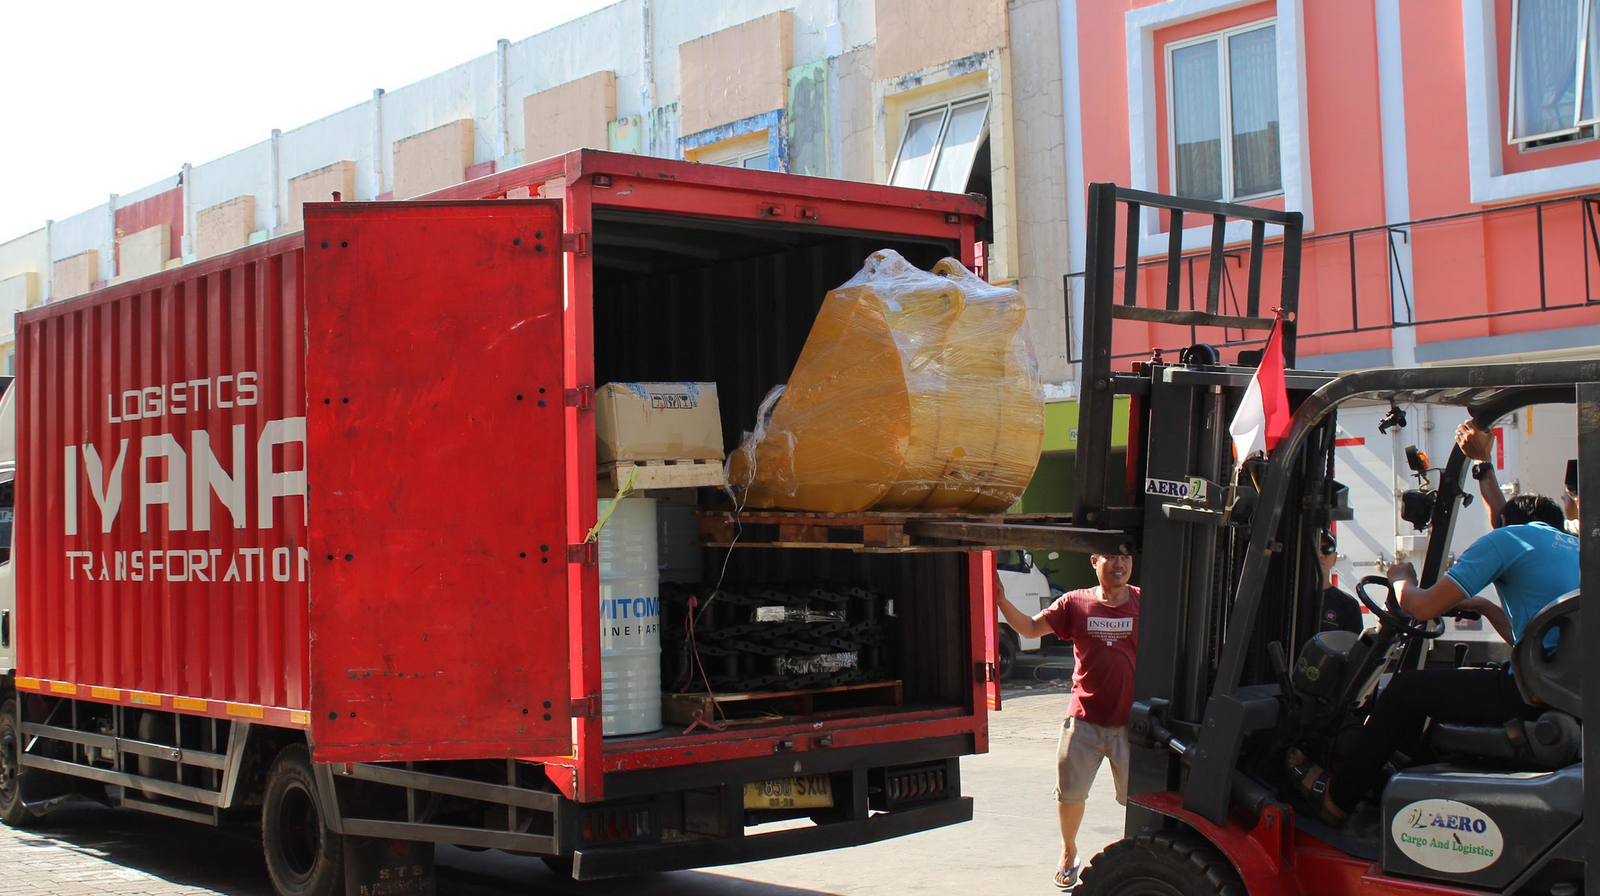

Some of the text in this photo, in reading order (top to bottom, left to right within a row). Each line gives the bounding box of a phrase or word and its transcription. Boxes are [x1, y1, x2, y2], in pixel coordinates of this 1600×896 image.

[108, 371, 258, 423] LOGISTICS
[64, 416, 307, 536] IVANA
[1147, 479, 1188, 497] AERO
[1089, 620, 1131, 629] INSIGHT
[1430, 812, 1487, 833] AERO
[1401, 832, 1494, 857] Cargo And Logistics
